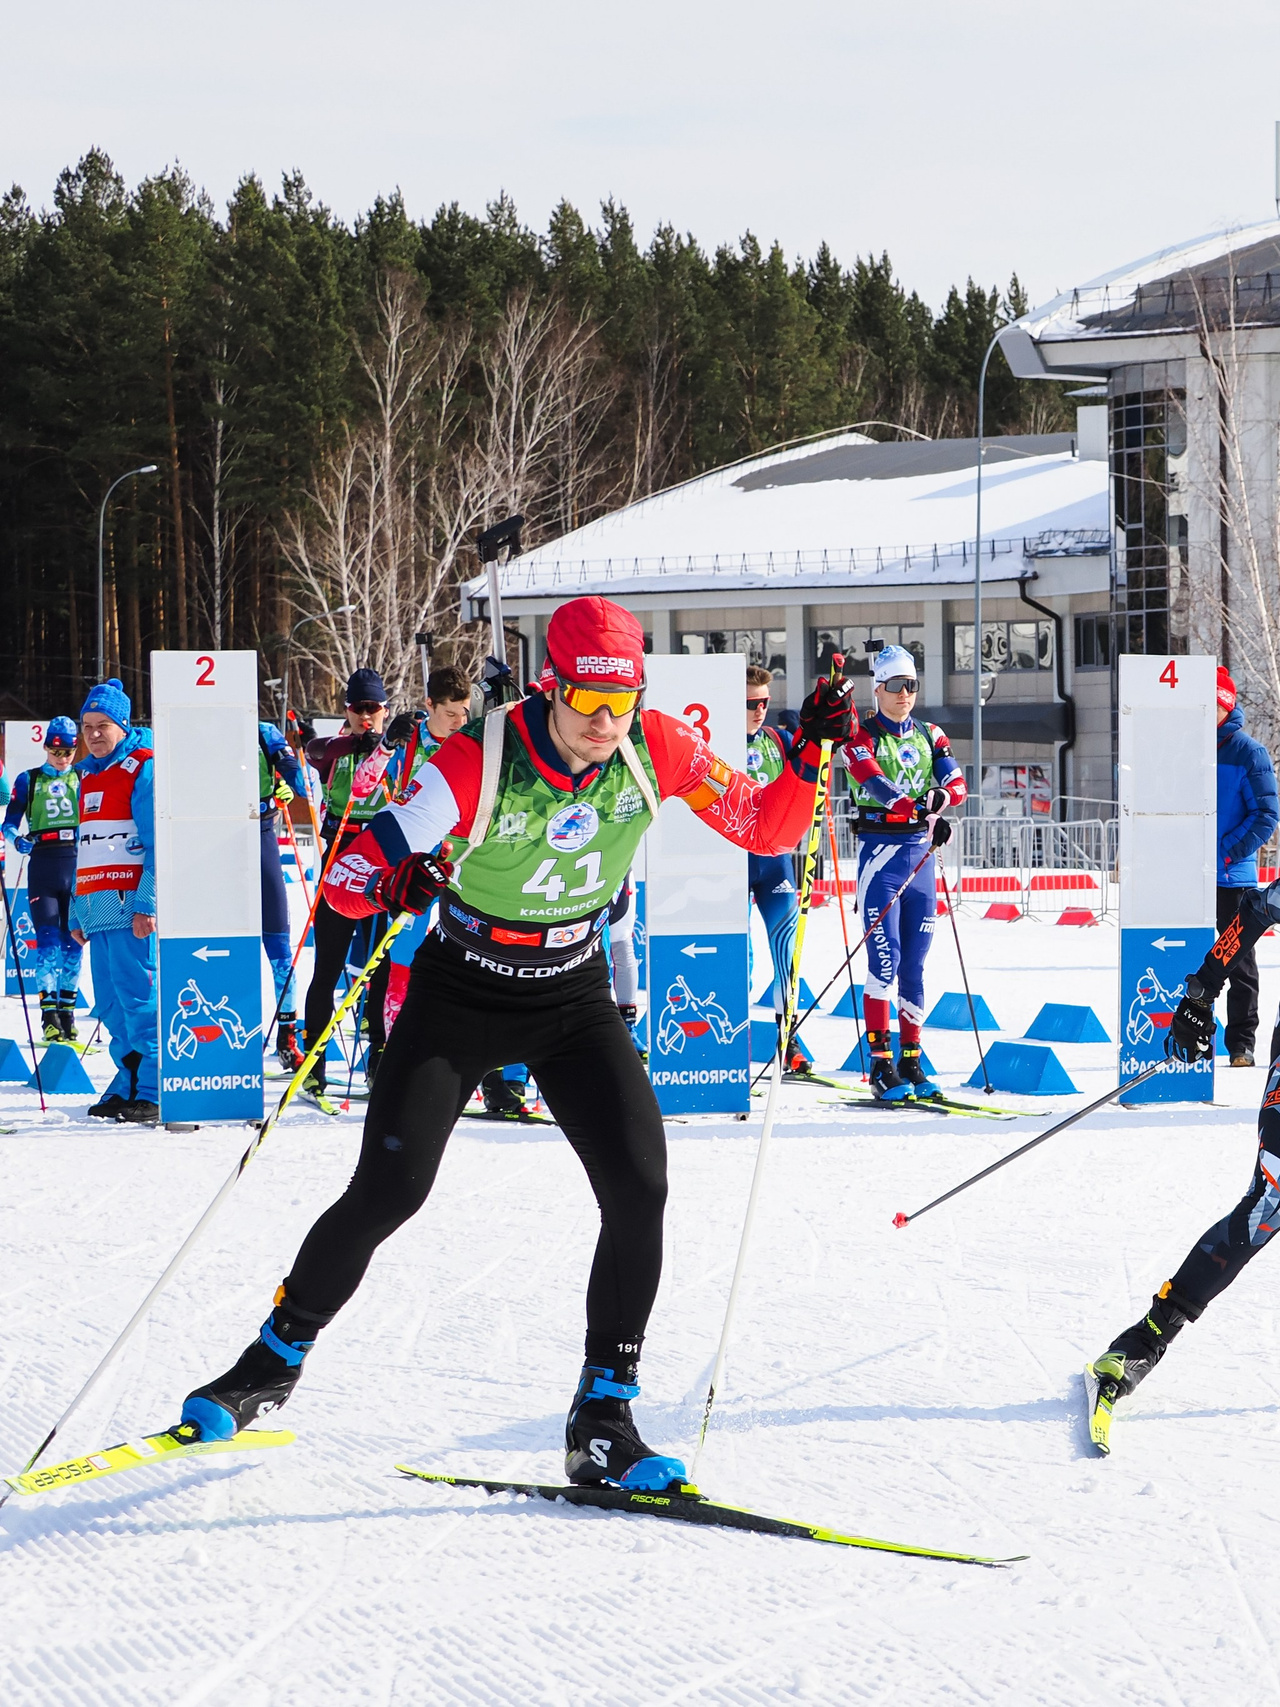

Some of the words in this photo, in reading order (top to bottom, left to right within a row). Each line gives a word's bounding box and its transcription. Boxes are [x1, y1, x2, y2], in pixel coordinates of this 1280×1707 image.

[195, 655, 216, 687] 2
[1159, 659, 1179, 689] 4
[31, 725, 43, 743] 3
[895, 769, 925, 795] 44
[45, 798, 74, 819] 59
[106, 869, 134, 880] край
[423, 860, 446, 883] LEKI
[521, 850, 607, 902] 41
[519, 897, 600, 917] КРАСНОЯРСК
[1210, 912, 1245, 961] ZERO
[464, 950, 514, 977] PRO
[516, 936, 602, 979] COMBAT
[163, 1074, 262, 1092] КРАСНОЯРСК
[652, 1068, 748, 1086] КРАСНОЯРСК
[617, 1342, 638, 1354] 191
[33, 1462, 94, 1488] FISCHER
[630, 1494, 671, 1507] FISCHER
